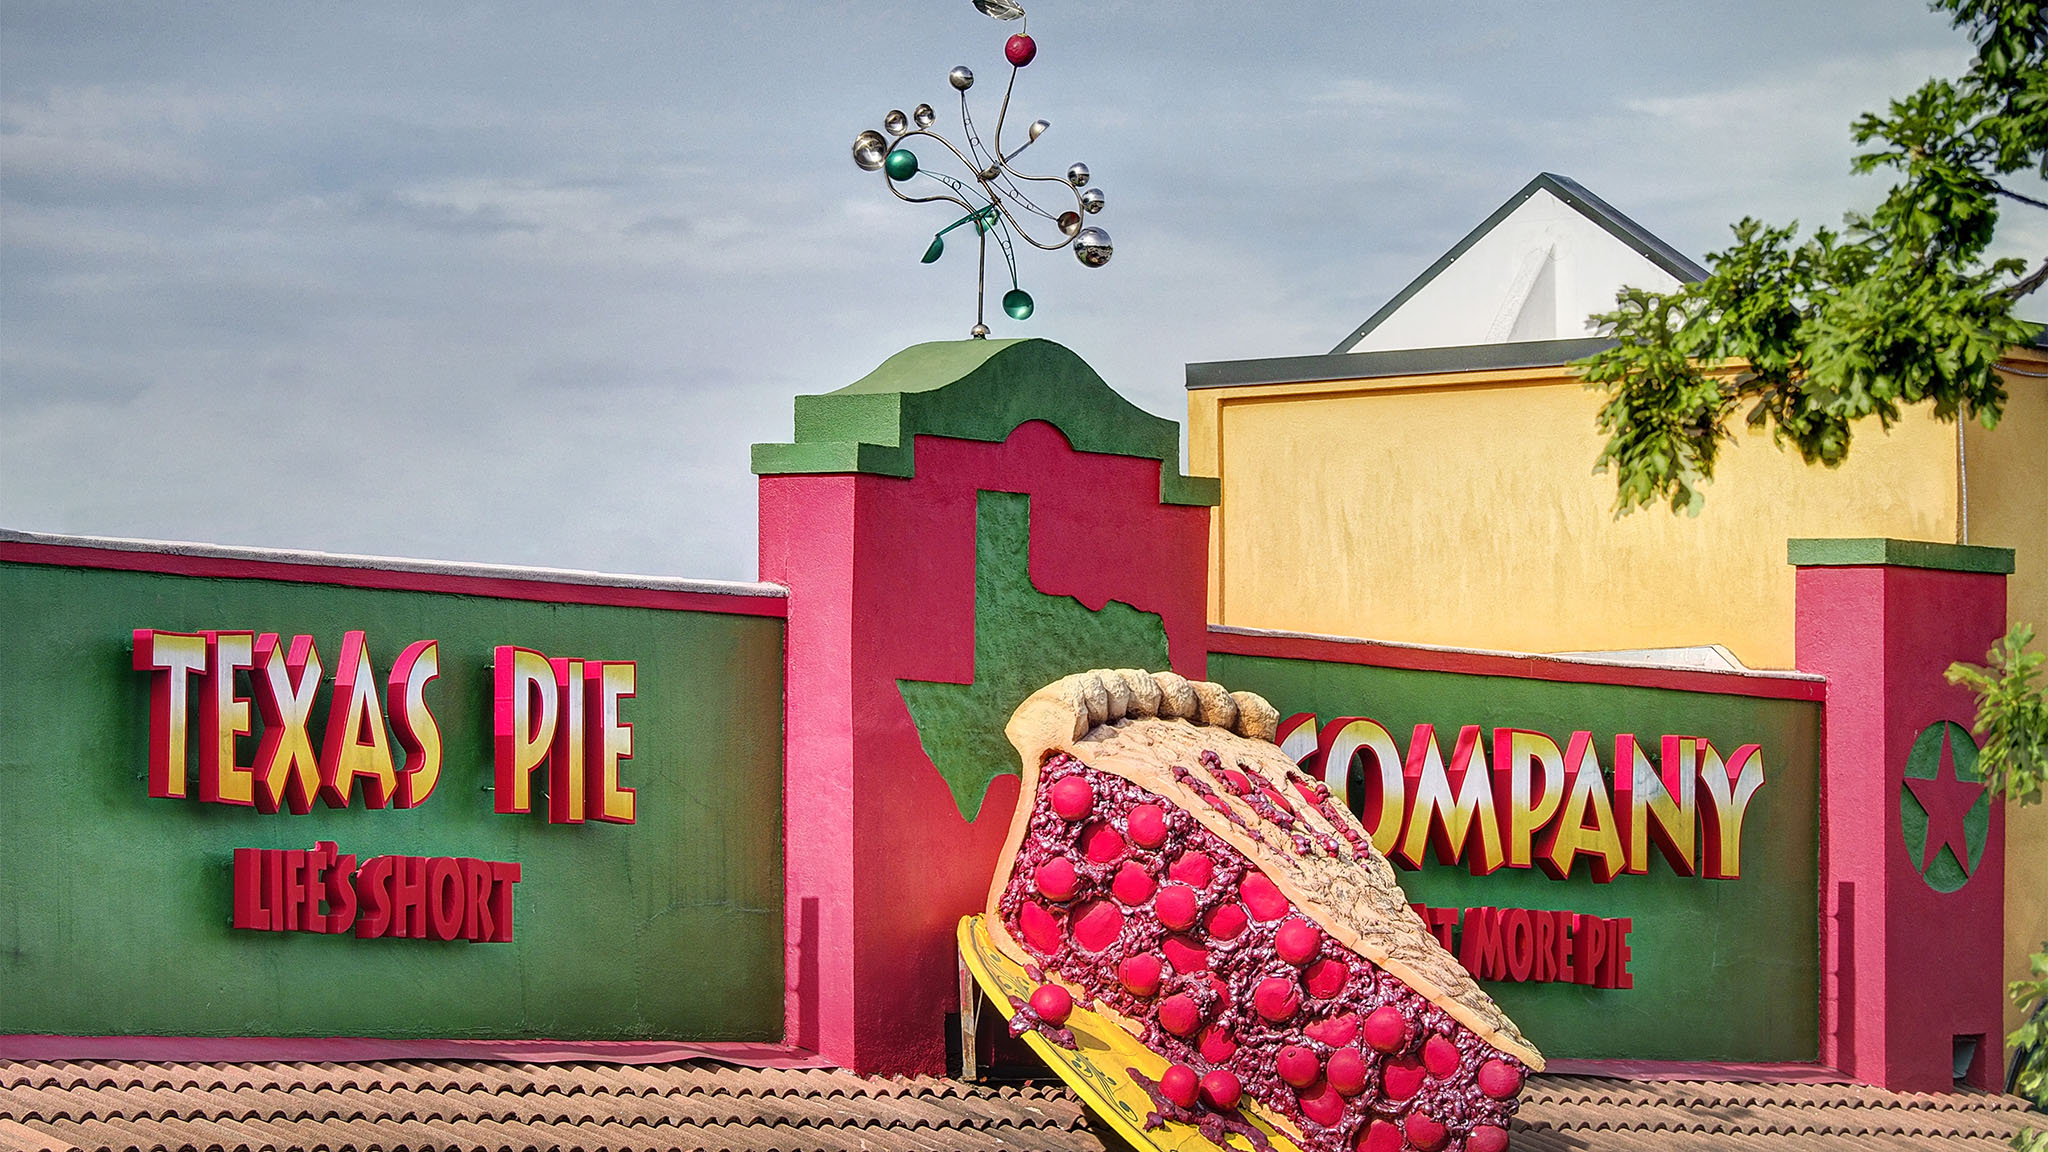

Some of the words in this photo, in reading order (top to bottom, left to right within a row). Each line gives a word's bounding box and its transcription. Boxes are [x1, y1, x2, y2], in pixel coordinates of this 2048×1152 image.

[133, 630, 442, 815] TEXAS
[494, 645, 636, 824] PIE
[234, 841, 357, 934] LIFE'S
[355, 855, 521, 943] SHORT
[1458, 906, 1574, 983] MORE
[1572, 914, 1633, 989] PIE
